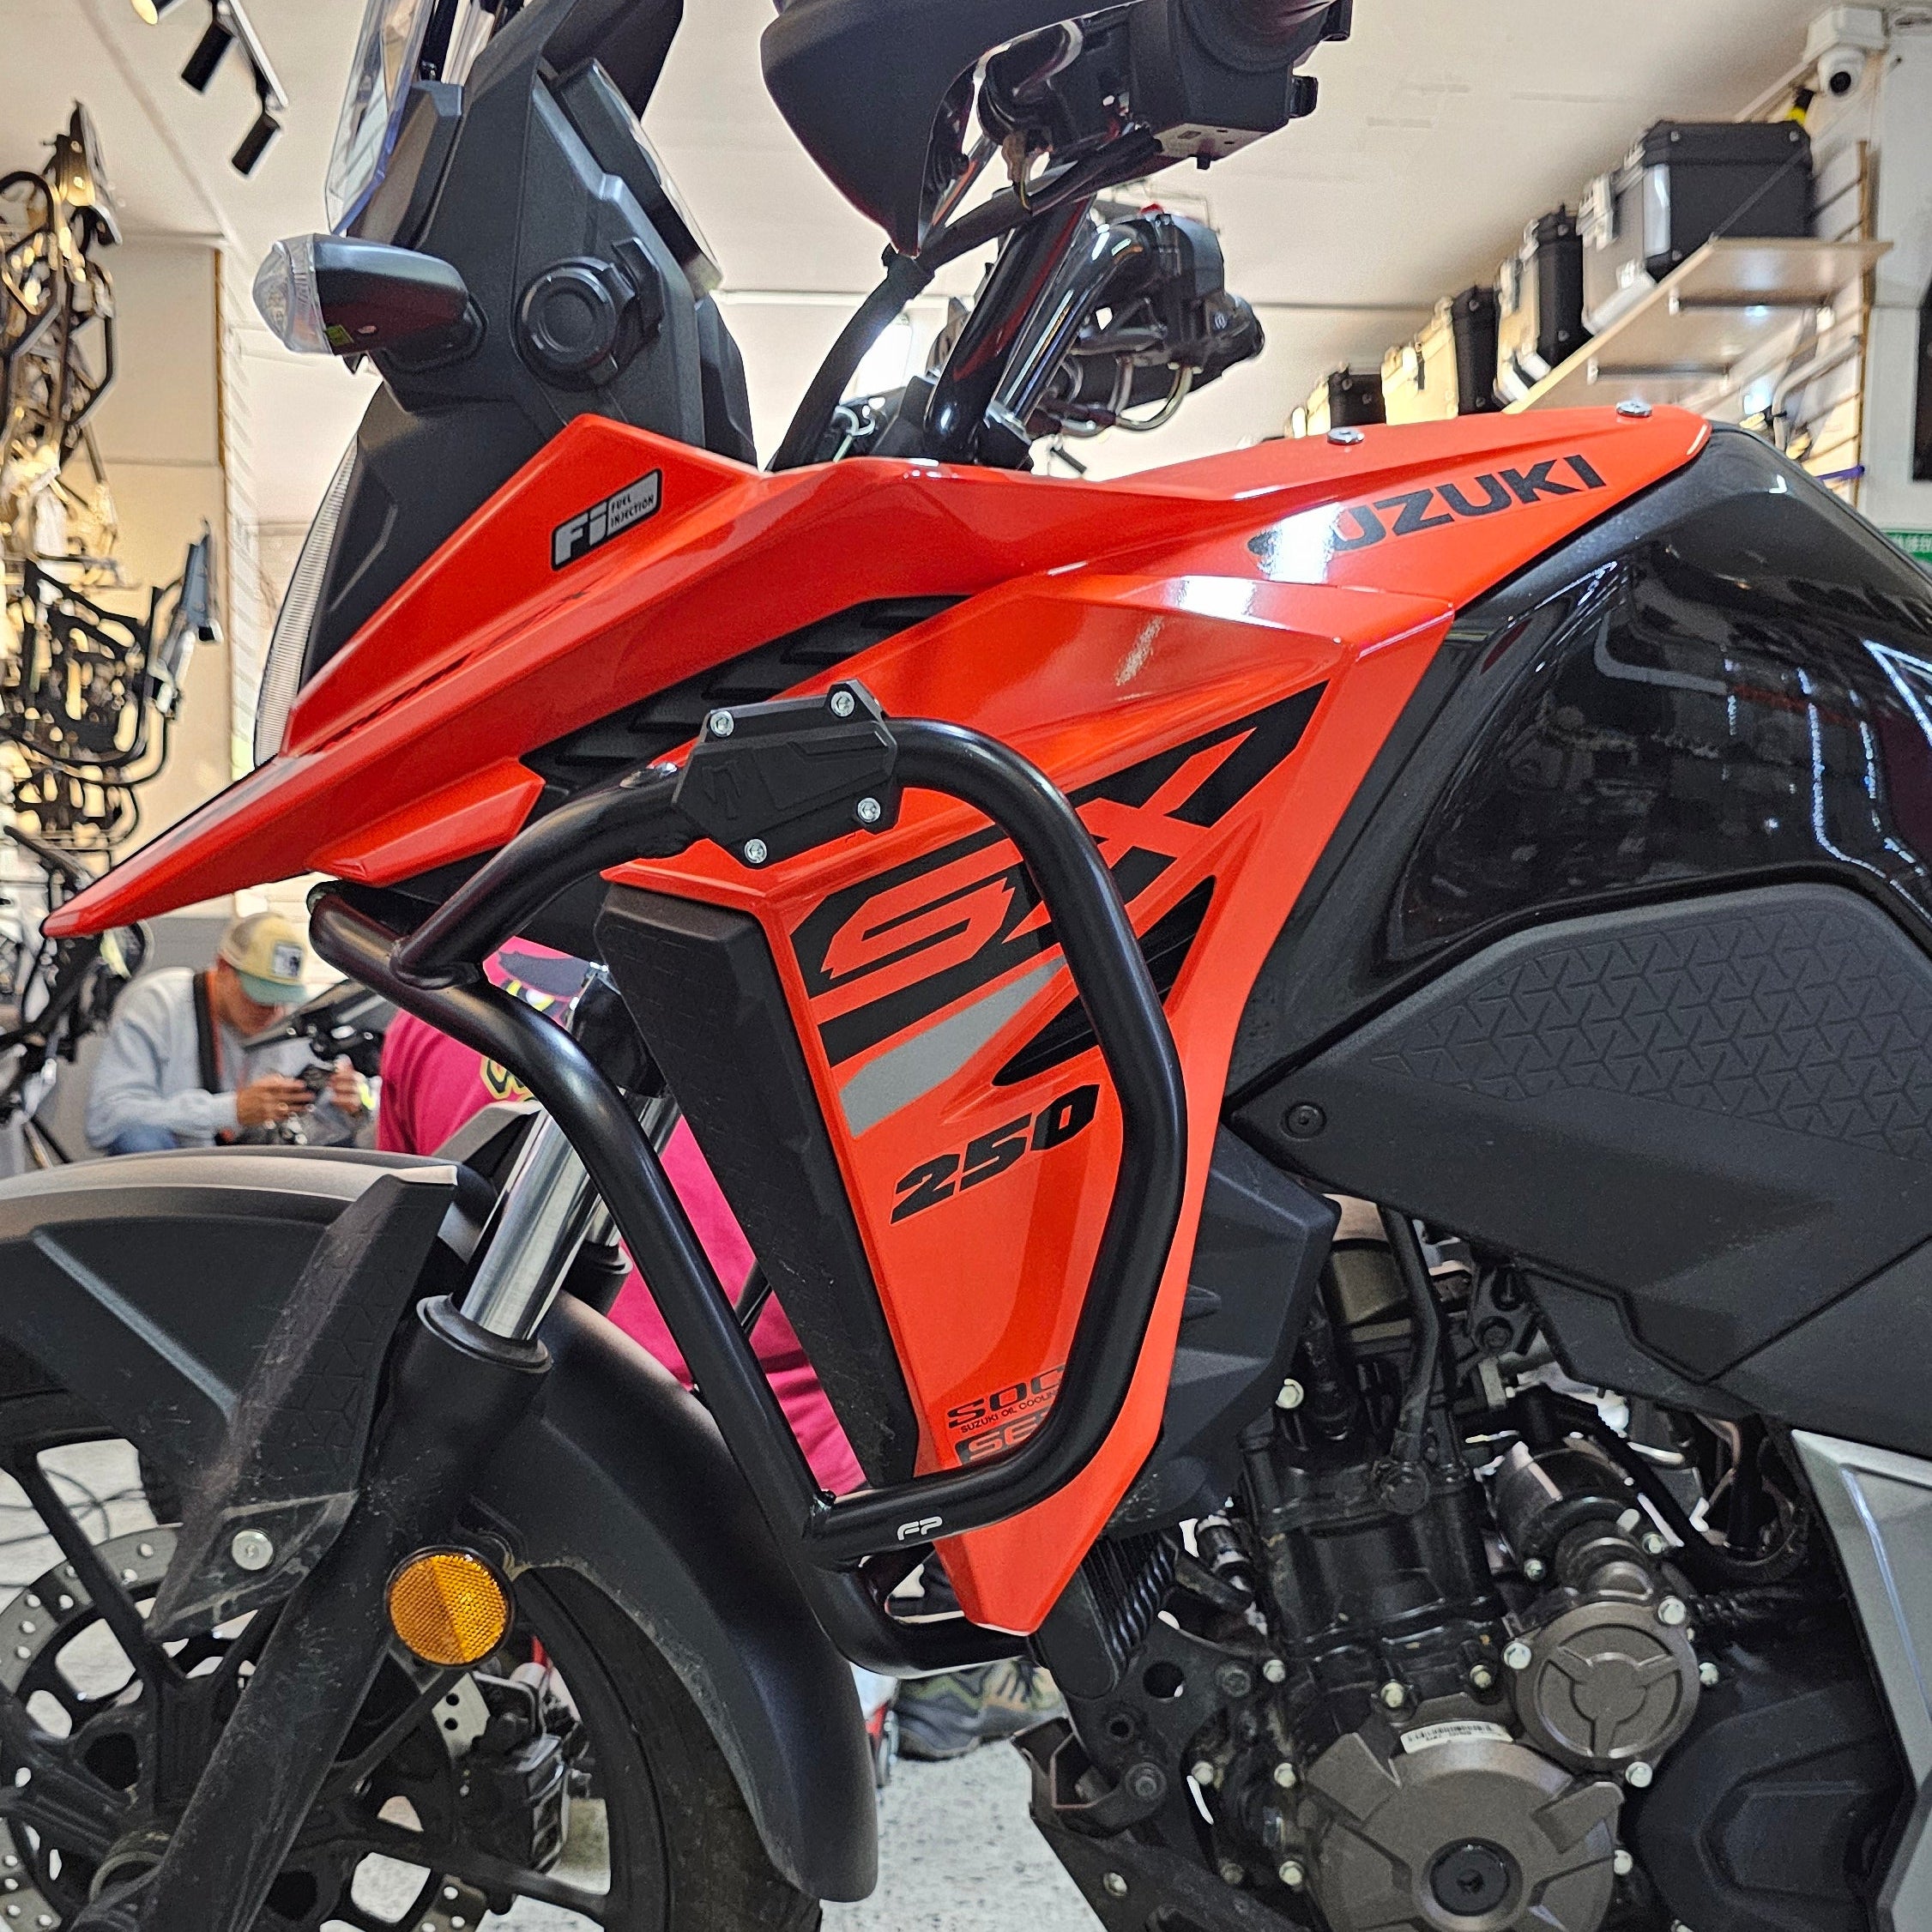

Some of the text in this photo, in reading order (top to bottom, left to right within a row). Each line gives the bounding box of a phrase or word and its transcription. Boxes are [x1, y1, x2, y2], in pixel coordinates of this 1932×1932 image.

[611, 494, 654, 528] INJECTION
[612, 493, 631, 513] FUEL
[1247, 455, 1606, 558] UZUKI
[891, 1084, 1099, 1224] 250
[961, 1415, 999, 1433] SUZUKI
[1001, 1407, 1017, 1417] OIL
[897, 1516, 943, 1541] FP
